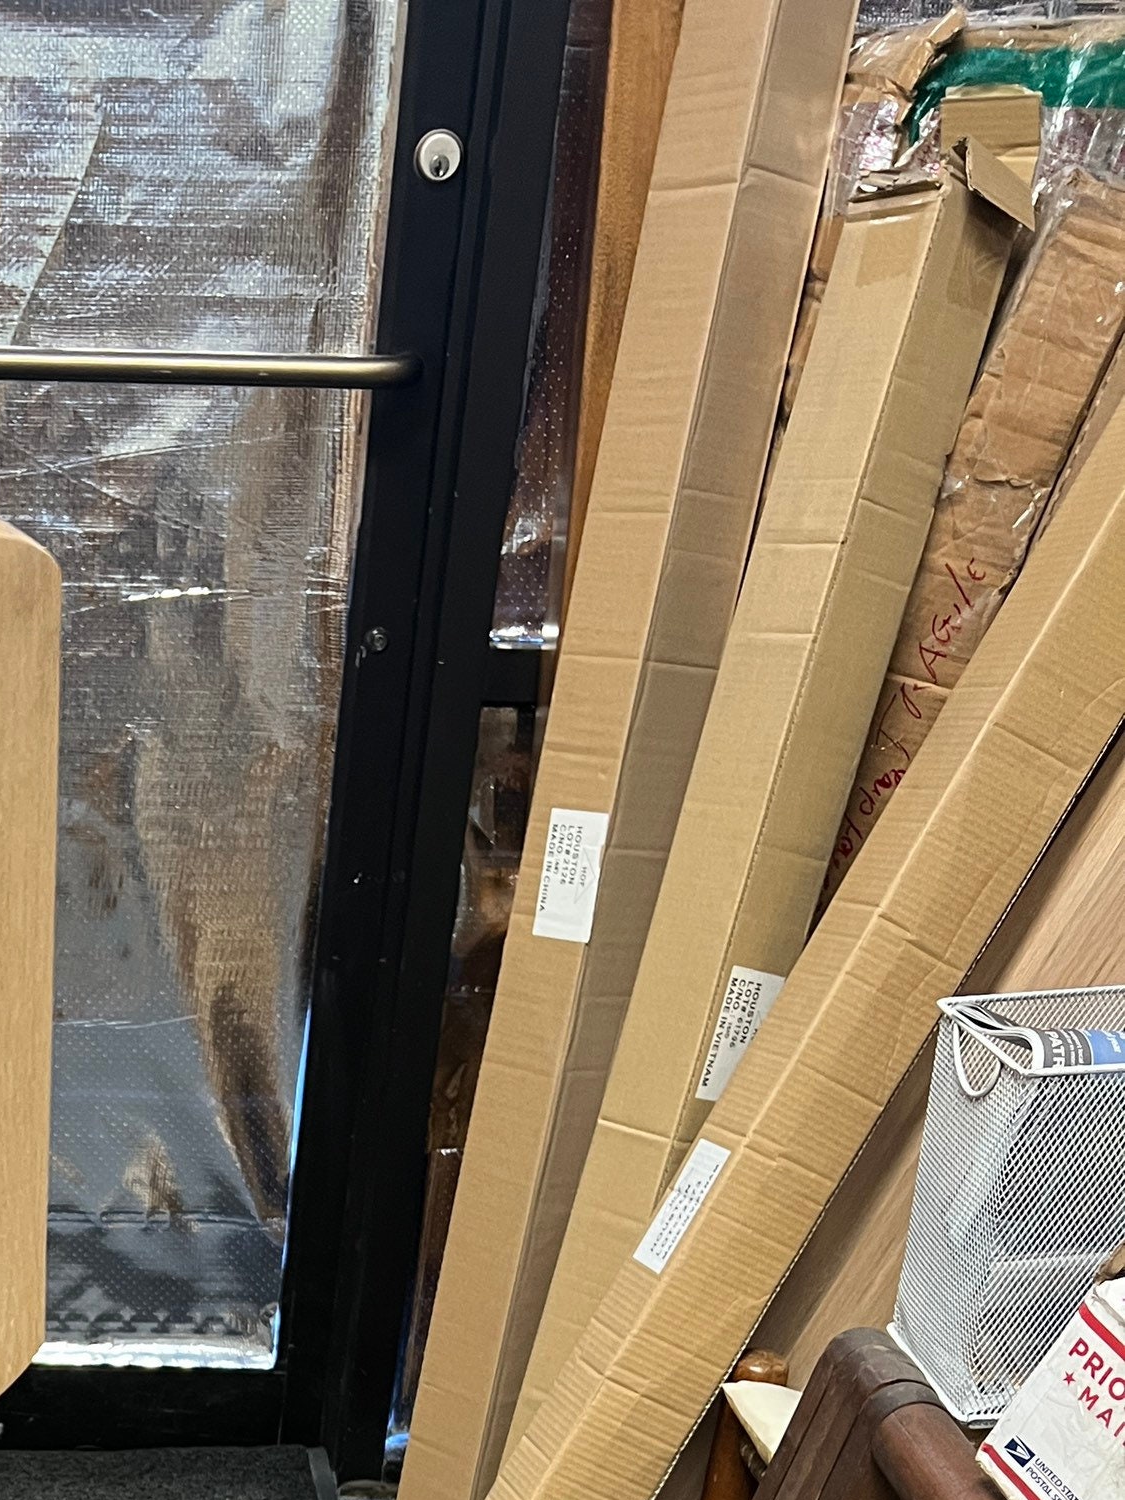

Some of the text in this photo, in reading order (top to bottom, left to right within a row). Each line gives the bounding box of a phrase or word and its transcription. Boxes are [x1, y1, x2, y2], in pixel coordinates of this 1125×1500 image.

[548, 823, 558, 856] MADE
[564, 825, 574, 855] LOT#
[568, 826, 582, 884] HOUSTON
[545, 861, 552, 871] IN
[539, 875, 550, 911] CHINA
[723, 977, 739, 1013] MADE
[740, 981, 754, 1013] LOT#
[718, 1016, 727, 1028] IN
[739, 982, 762, 1044] HOUSTON
[701, 1031, 722, 1087] VIETNAM
[1068, 1337, 1125, 1411] PRIO
[1077, 1385, 1125, 1447] MAI
[1025, 1466, 1053, 1497] POSTAL
[1034, 1457, 1063, 1488] UNITED
